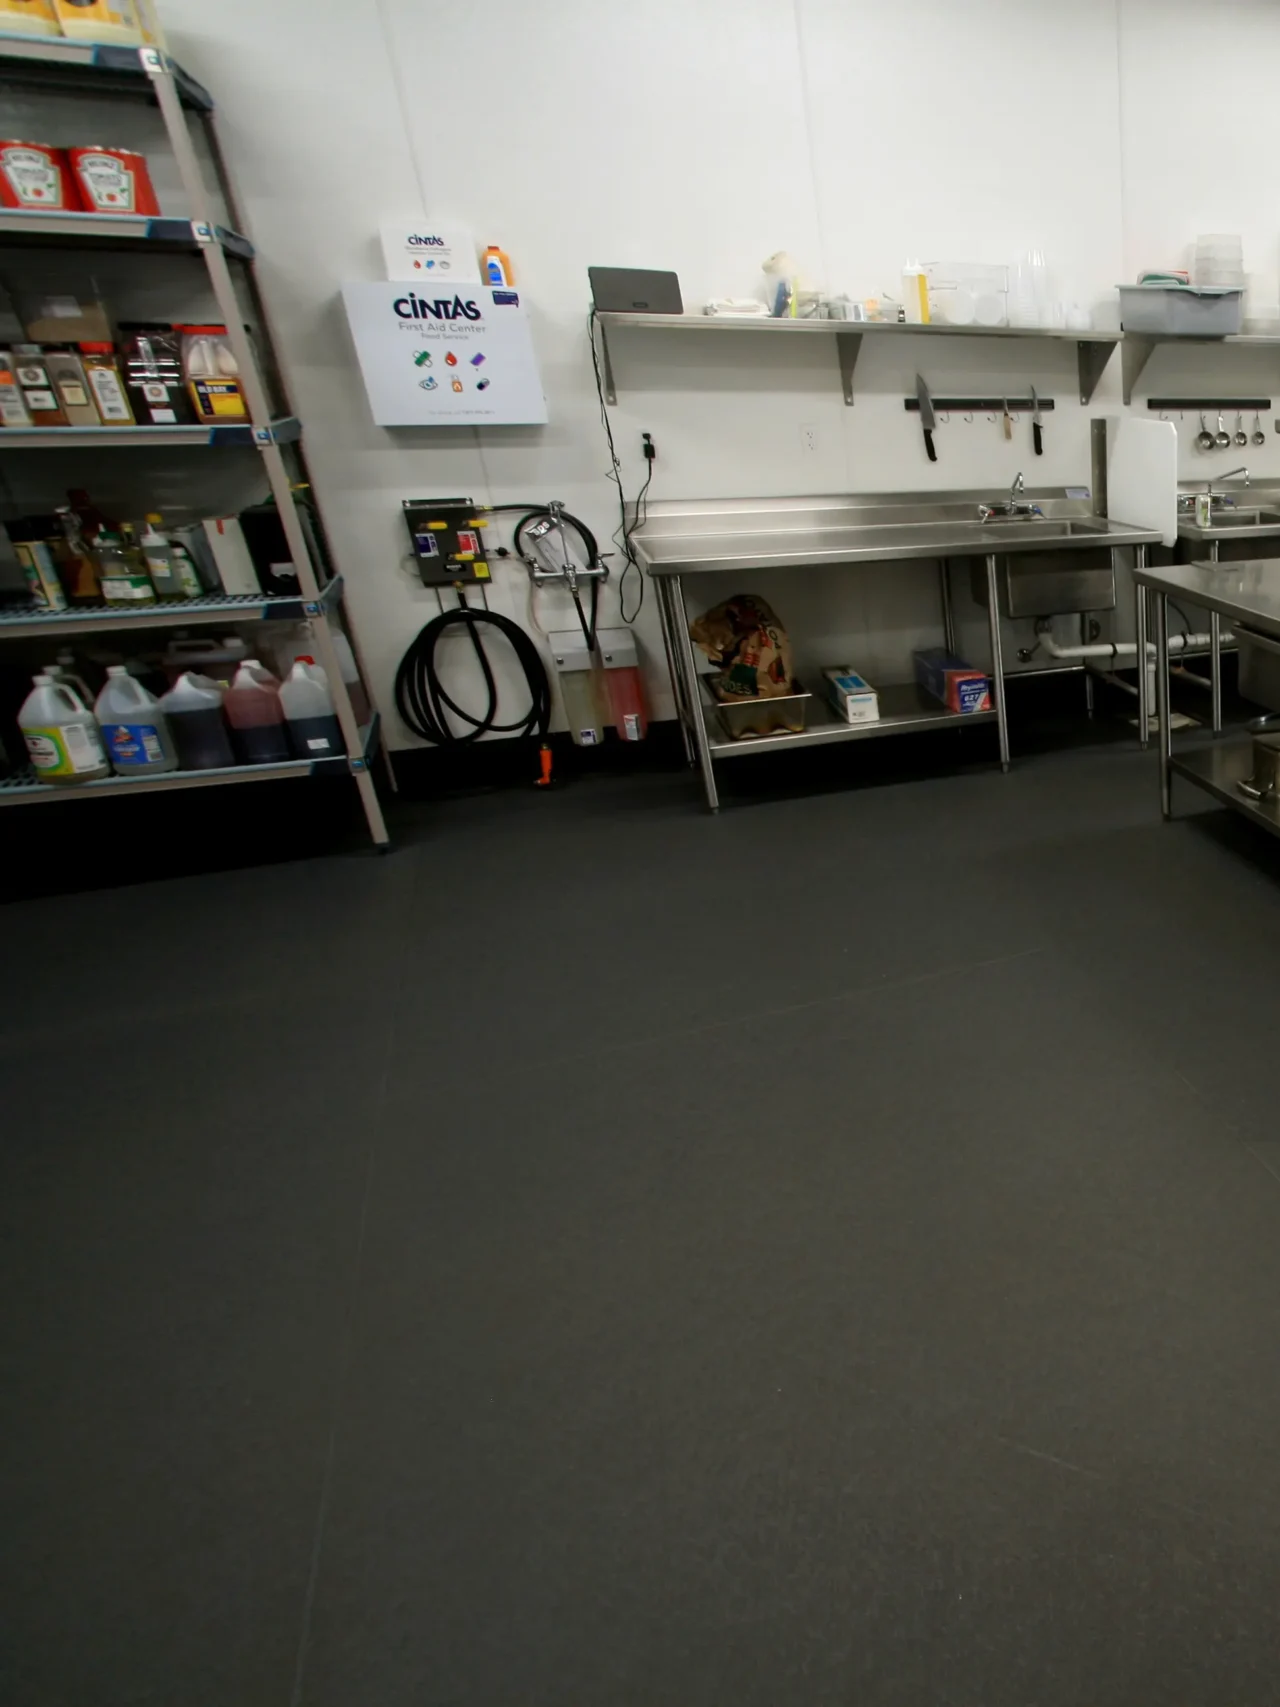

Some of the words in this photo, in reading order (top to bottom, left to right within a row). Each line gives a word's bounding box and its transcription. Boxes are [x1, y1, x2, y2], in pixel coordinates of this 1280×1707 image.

[398, 321, 424, 332] First
[427, 322, 446, 332] Aid
[449, 323, 486, 333] Center
[442, 333, 469, 341] Service
